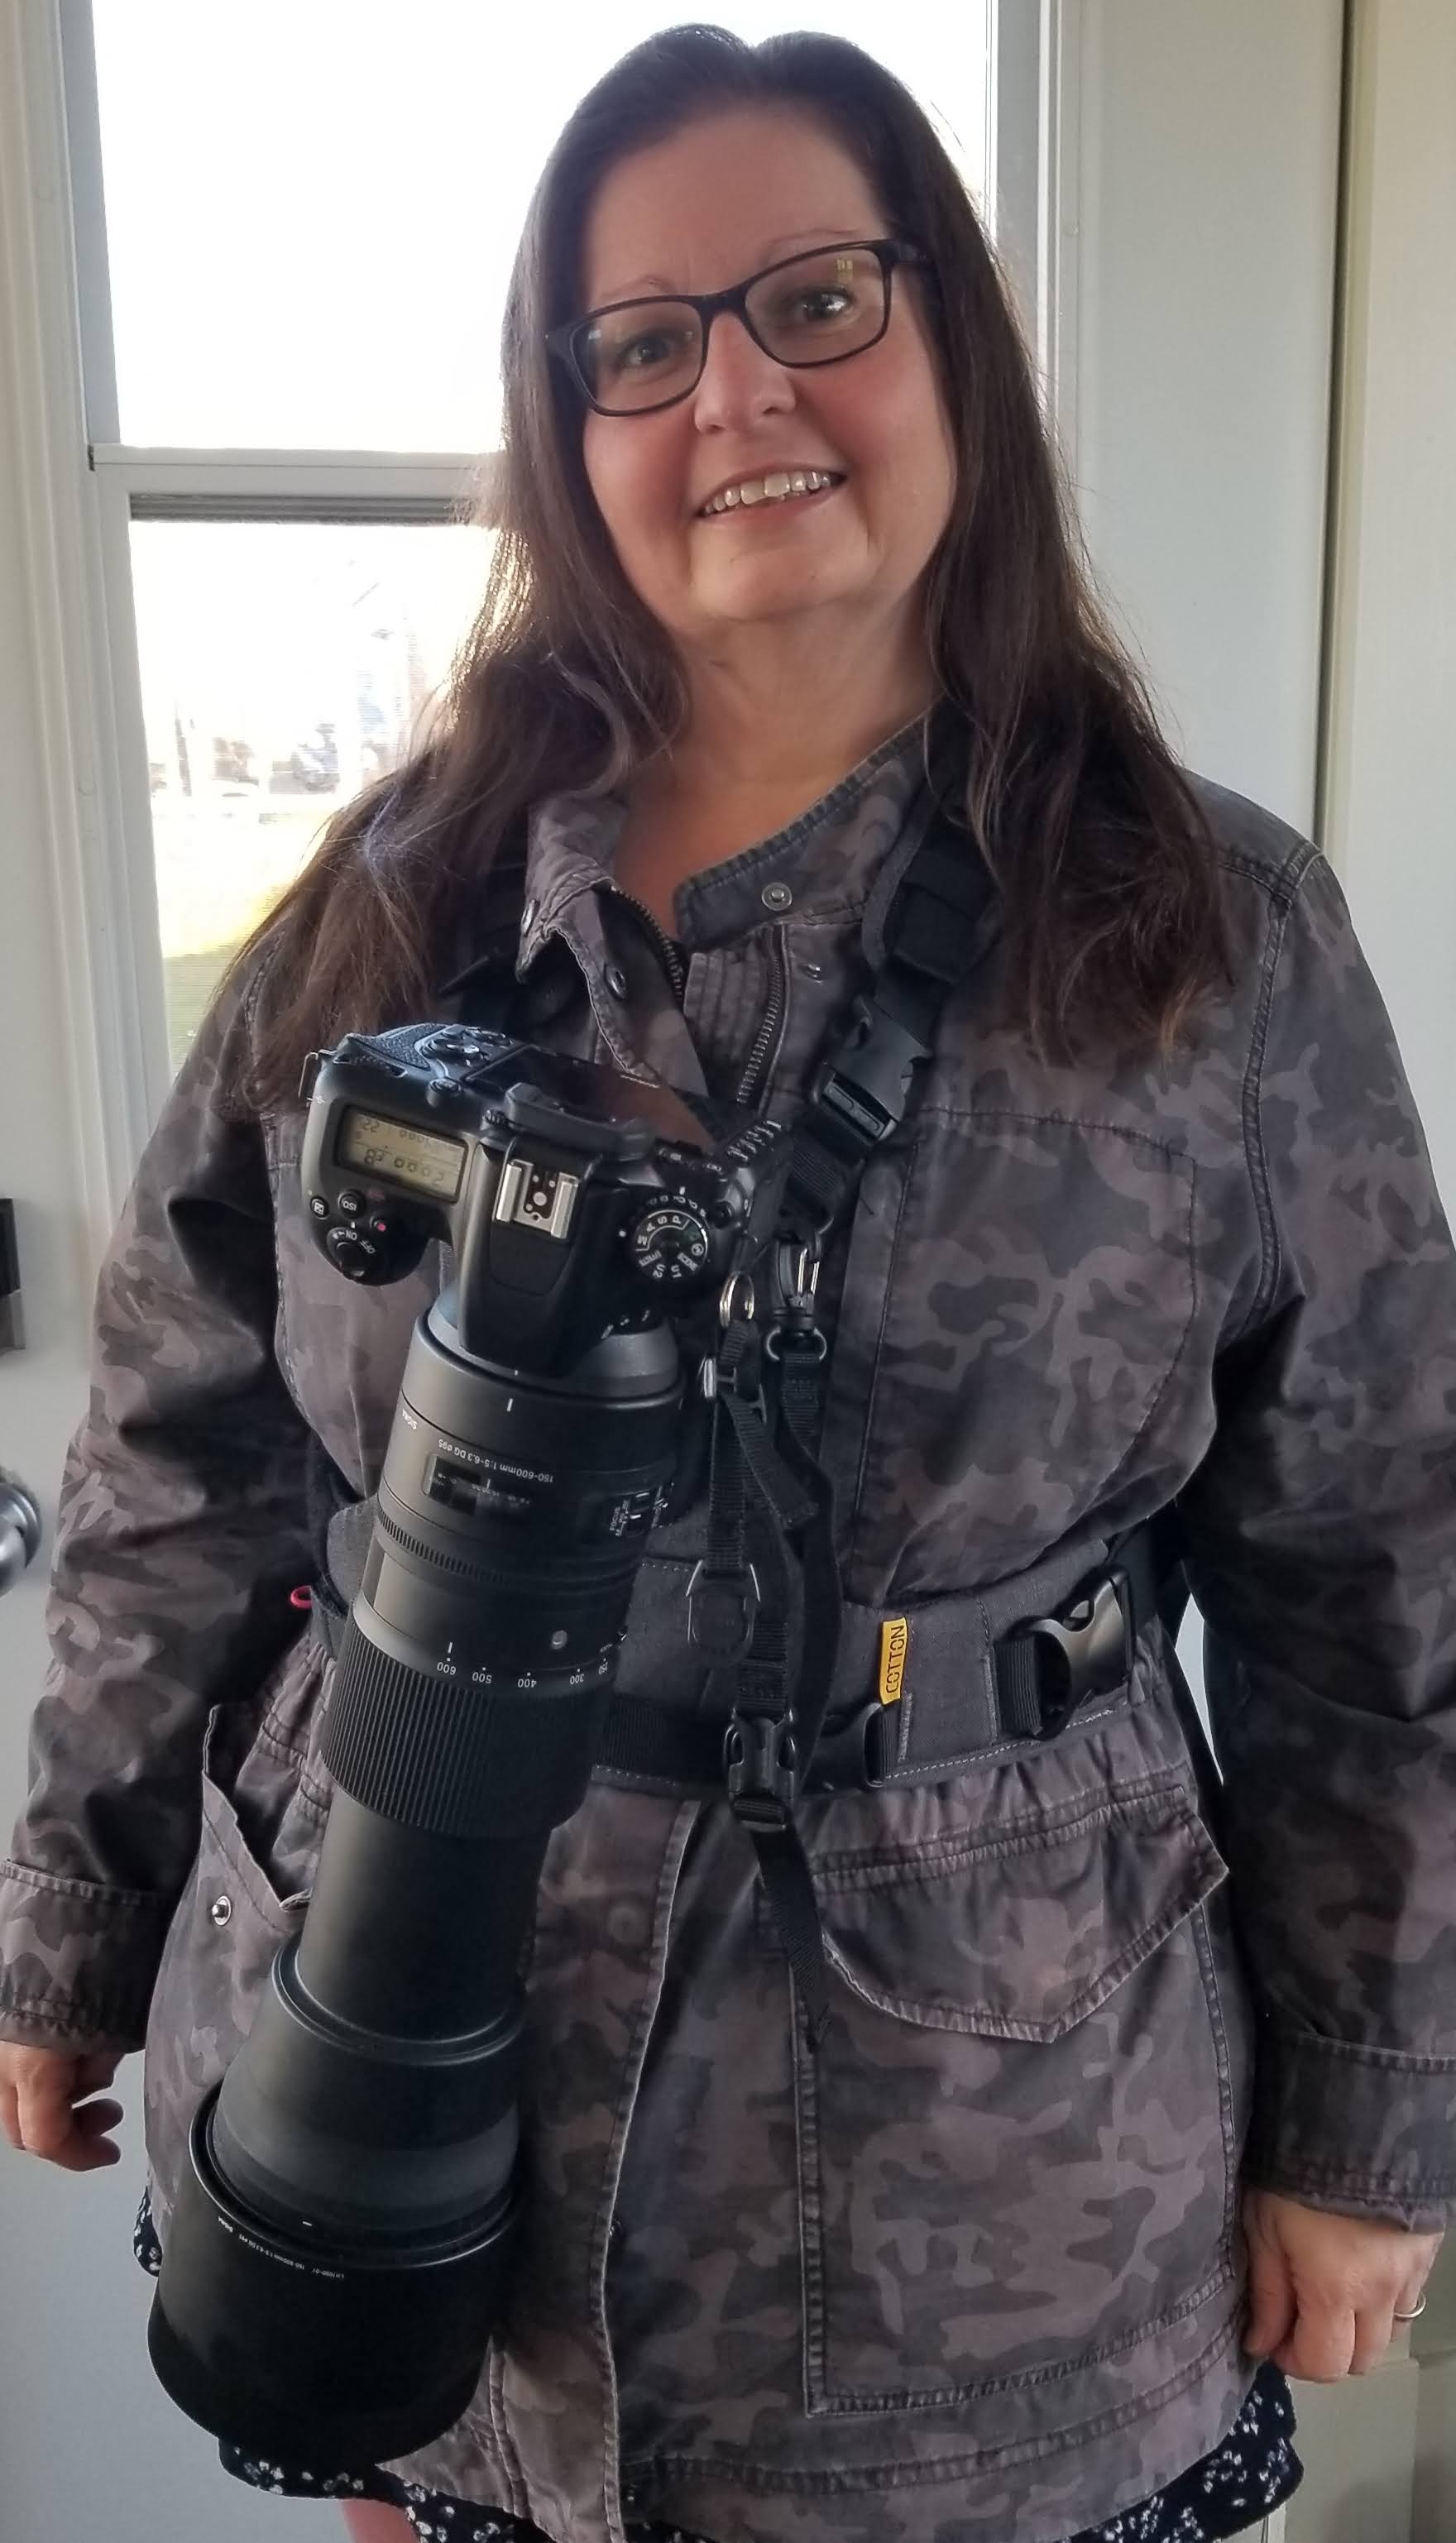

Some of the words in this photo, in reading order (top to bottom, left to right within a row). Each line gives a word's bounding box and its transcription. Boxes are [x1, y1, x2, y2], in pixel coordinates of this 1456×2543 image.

[342, 1200, 357, 1211] ISO
[658, 1215, 668, 1225] S
[672, 1215, 682, 1224] P
[646, 1222, 656, 1233] A
[345, 1230, 357, 1241] ON
[637, 1234, 648, 1246] M
[359, 1240, 376, 1254] OFF
[652, 1263, 666, 1278] U2
[671, 1265, 682, 1278] U1
[454, 1448, 466, 1459] DG
[467, 1453, 496, 1470] 1:5-6.3
[499, 1463, 553, 1483] 150-600mm
[885, 1624, 905, 1693] COTTON
[437, 1661, 457, 1676] 600
[472, 1671, 492, 1684] 500
[517, 1678, 538, 1688] 400
[569, 1673, 585, 1685] 300
